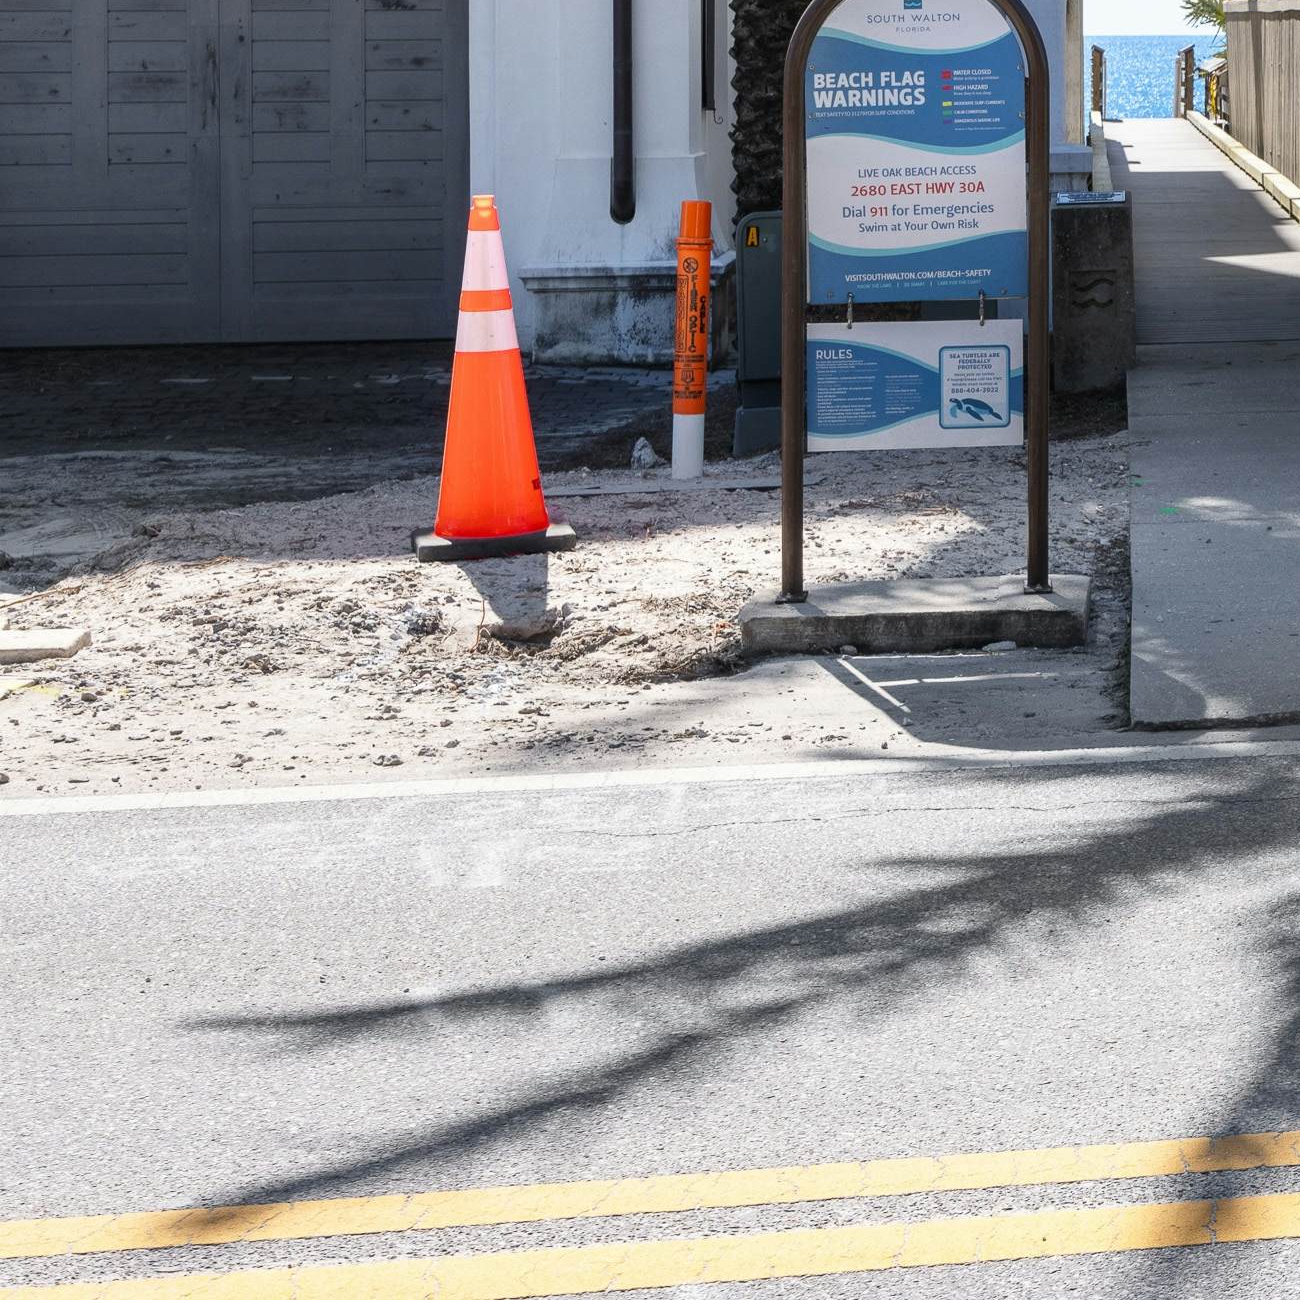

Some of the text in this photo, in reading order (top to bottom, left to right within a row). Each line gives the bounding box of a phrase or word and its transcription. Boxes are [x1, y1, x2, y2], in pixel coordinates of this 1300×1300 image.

[866, 13, 960, 24] SOUTH WALTON
[813, 70, 925, 89] BEACH FLAG
[813, 87, 926, 109] WARNINGS
[858, 165, 977, 179] LIVE OAK BEACH ACCESS
[851, 181, 985, 197] 2680 EAST HWY 30A
[842, 201, 994, 218] Dial 911 for Emergencies
[858, 219, 980, 233] Swim at Your Own Risk
[747, 227, 758, 246] A
[815, 349, 853, 360] RULES
